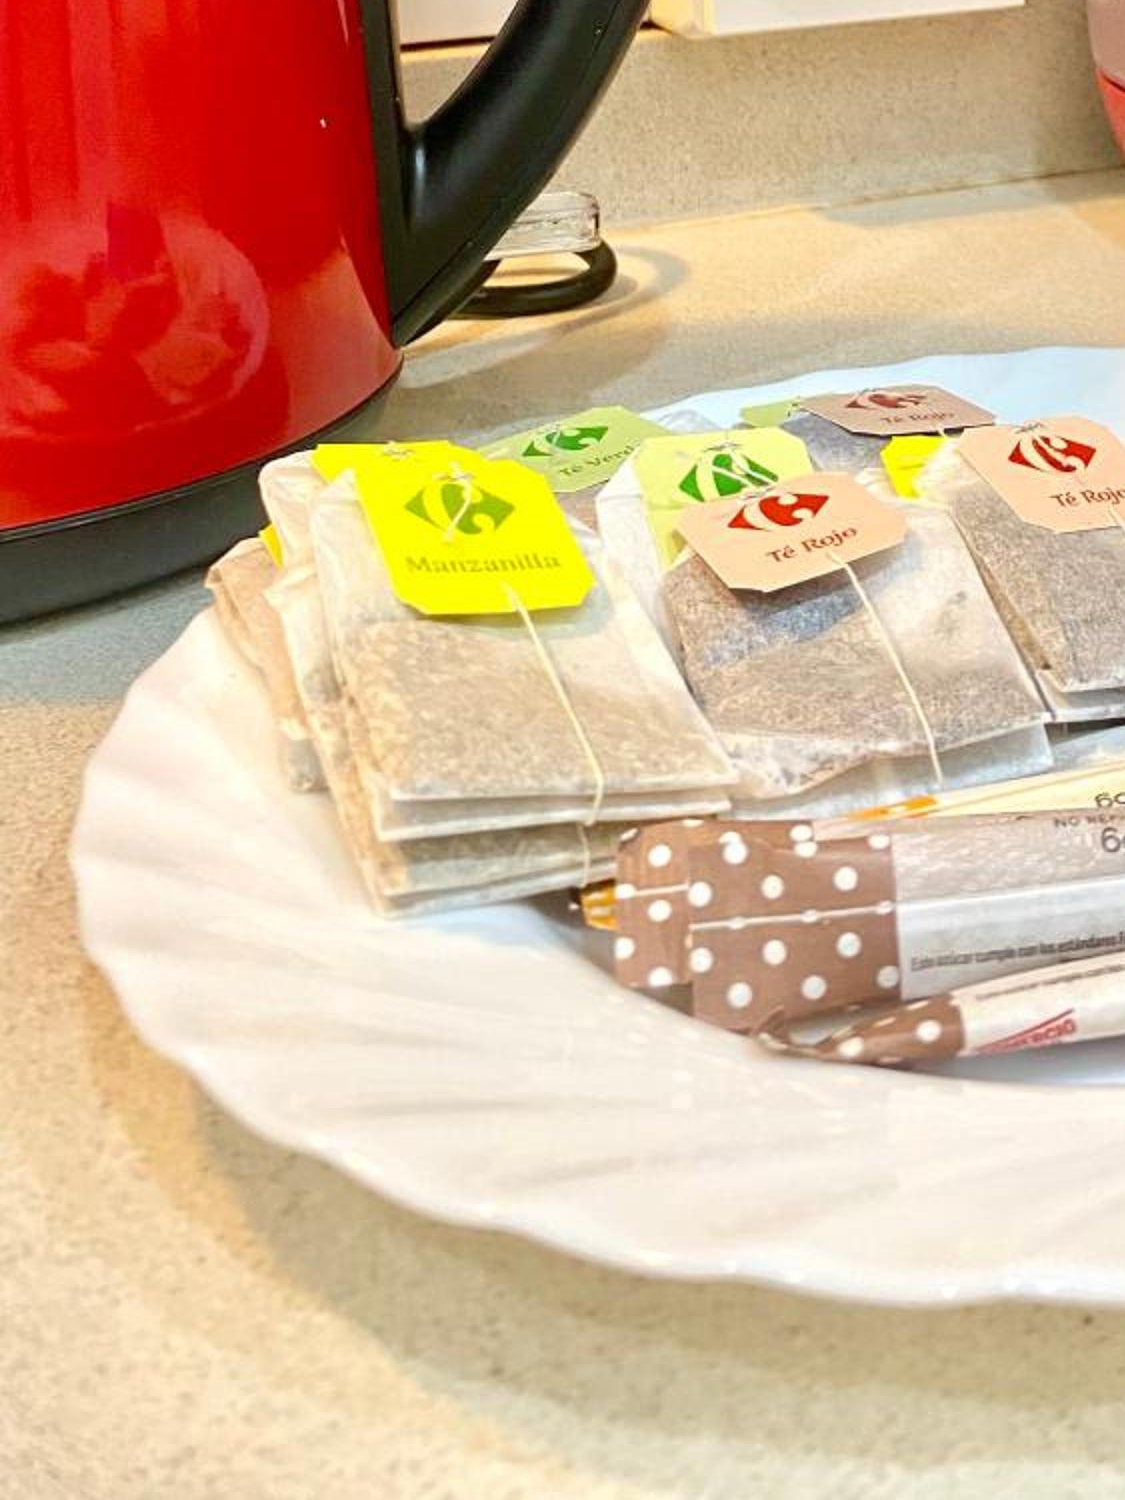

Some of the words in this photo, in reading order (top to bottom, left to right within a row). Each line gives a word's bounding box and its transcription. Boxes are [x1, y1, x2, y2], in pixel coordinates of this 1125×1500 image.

[1049, 491, 1078, 508] Té
[766, 545, 796, 565] Té
[801, 526, 858, 552] Rojo
[404, 554, 563, 575] Manzanilla
